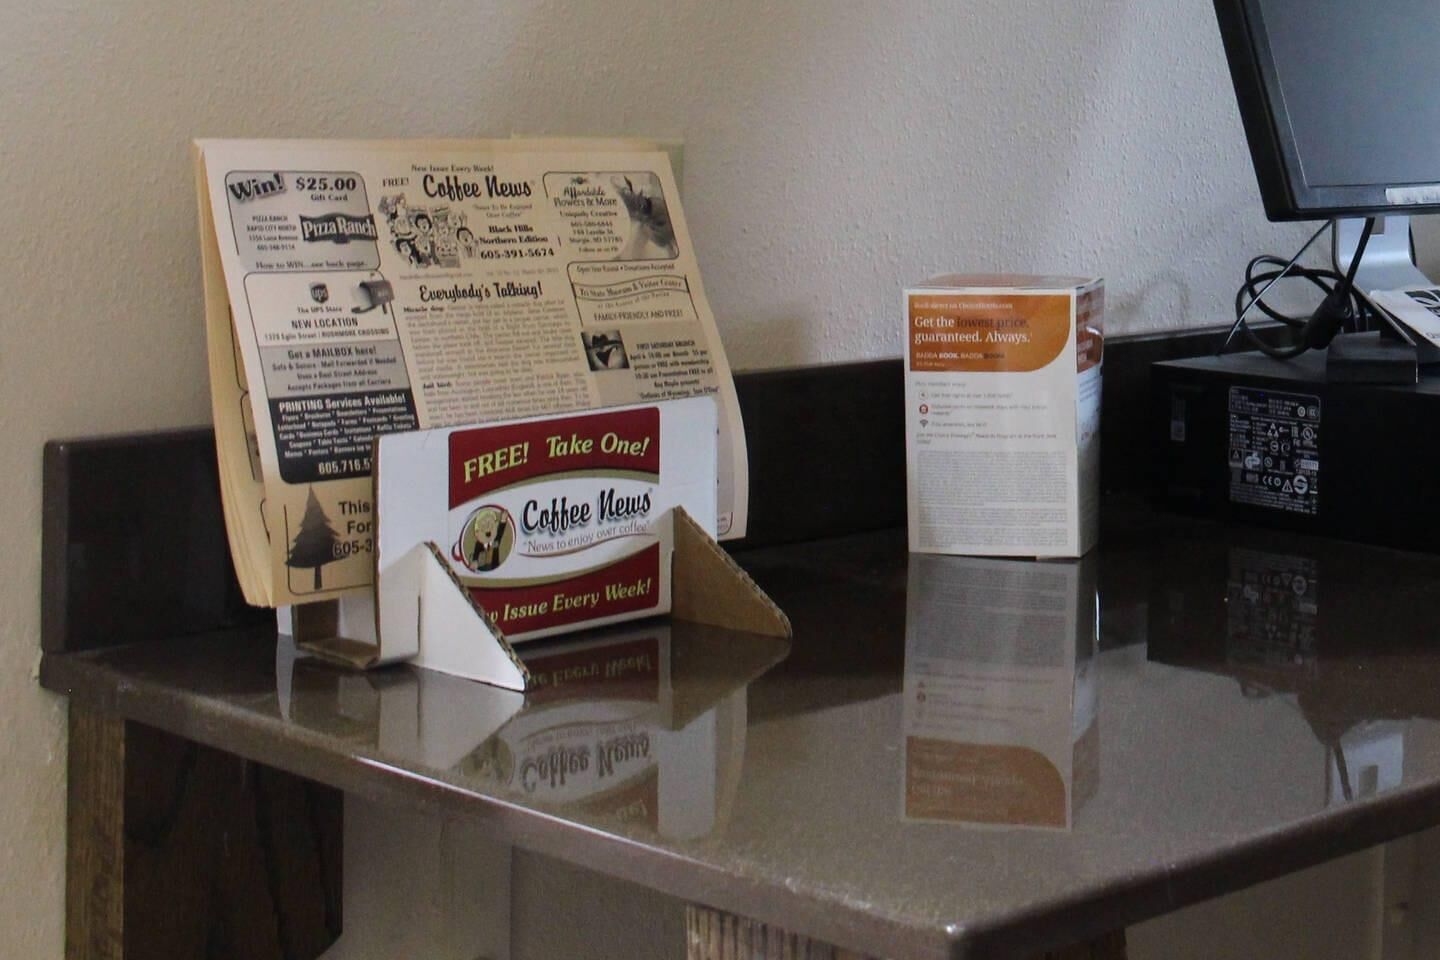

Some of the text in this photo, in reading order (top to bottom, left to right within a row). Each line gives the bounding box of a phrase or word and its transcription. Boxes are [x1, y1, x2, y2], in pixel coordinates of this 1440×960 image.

[228, 172, 283, 200] Win!
[296, 177, 357, 191] $25.00
[382, 177, 409, 187] FREE!
[423, 174, 532, 201] Coffee News
[595, 197, 617, 206] More
[303, 216, 377, 239] Pizza Ranch
[488, 224, 533, 233] Black Hills
[519, 235, 548, 243] Edition
[420, 281, 543, 303] Everybody's Talking!
[291, 317, 358, 329] NEW LOCATION
[914, 316, 934, 328] Get
[936, 315, 955, 328] the
[957, 316, 993, 328] lowest
[914, 331, 982, 344] guaranteed.
[288, 349, 303, 360] Get
[312, 347, 353, 359] MAILBOX
[355, 345, 376, 356] here!
[279, 393, 406, 413] PRINTING Services Available!
[463, 432, 650, 484] FREE! Take One!
[319, 458, 373, 474] 605.716.5
[338, 501, 370, 515] This
[522, 488, 651, 533] Coffee News
[557, 538, 567, 551] to
[568, 534, 594, 549] enjoy
[597, 526, 616, 538] over
[503, 600, 548, 621] Issue
[552, 591, 599, 610] Every
[605, 578, 652, 601] Week!
